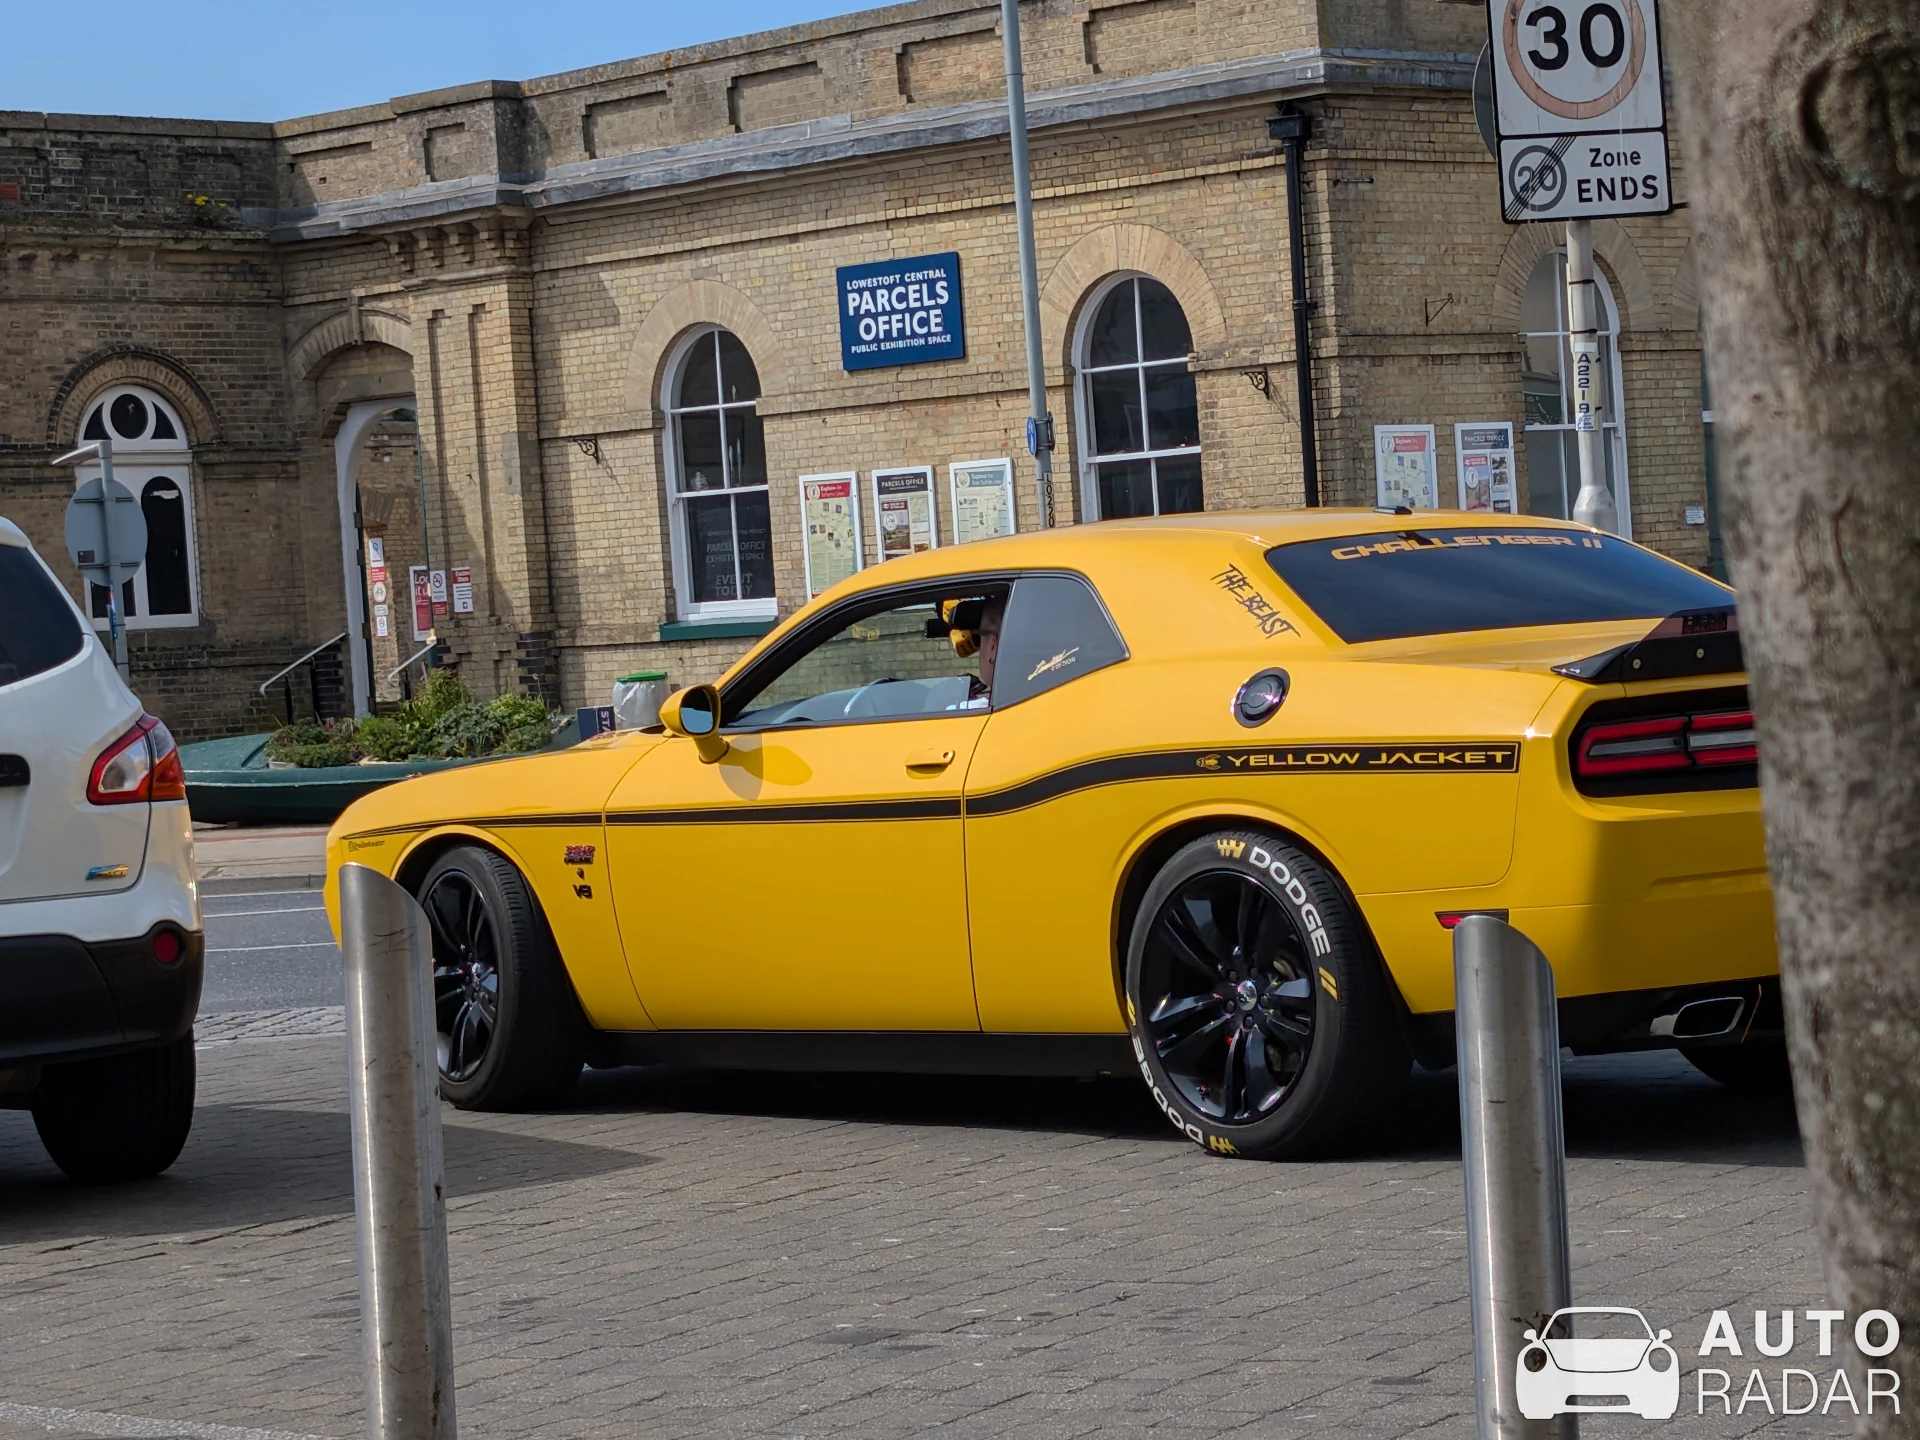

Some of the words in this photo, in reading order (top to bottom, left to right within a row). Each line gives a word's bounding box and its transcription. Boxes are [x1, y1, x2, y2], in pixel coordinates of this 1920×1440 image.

[1525, 2, 1625, 71] 30
[1589, 148, 1641, 167] Zone
[1577, 174, 1659, 203] ENDS
[846, 274, 901, 291] LOWESTOFT
[904, 268, 947, 282] CENTRAL
[847, 281, 949, 317] PARCELS
[859, 309, 944, 341] OFFICE
[851, 343, 878, 354] PUBLIC
[880, 337, 925, 351] EXHIBITION
[928, 334, 951, 346] SPACE
[1331, 535, 1576, 560] CHALLENGER
[1210, 563, 1253, 600] THE
[1235, 592, 1301, 640] BEAST
[1226, 752, 1360, 767] YELLOW
[1368, 751, 1512, 765] JACKET
[1249, 846, 1331, 957] DODGE
[1132, 1037, 1206, 1145] DODGE
